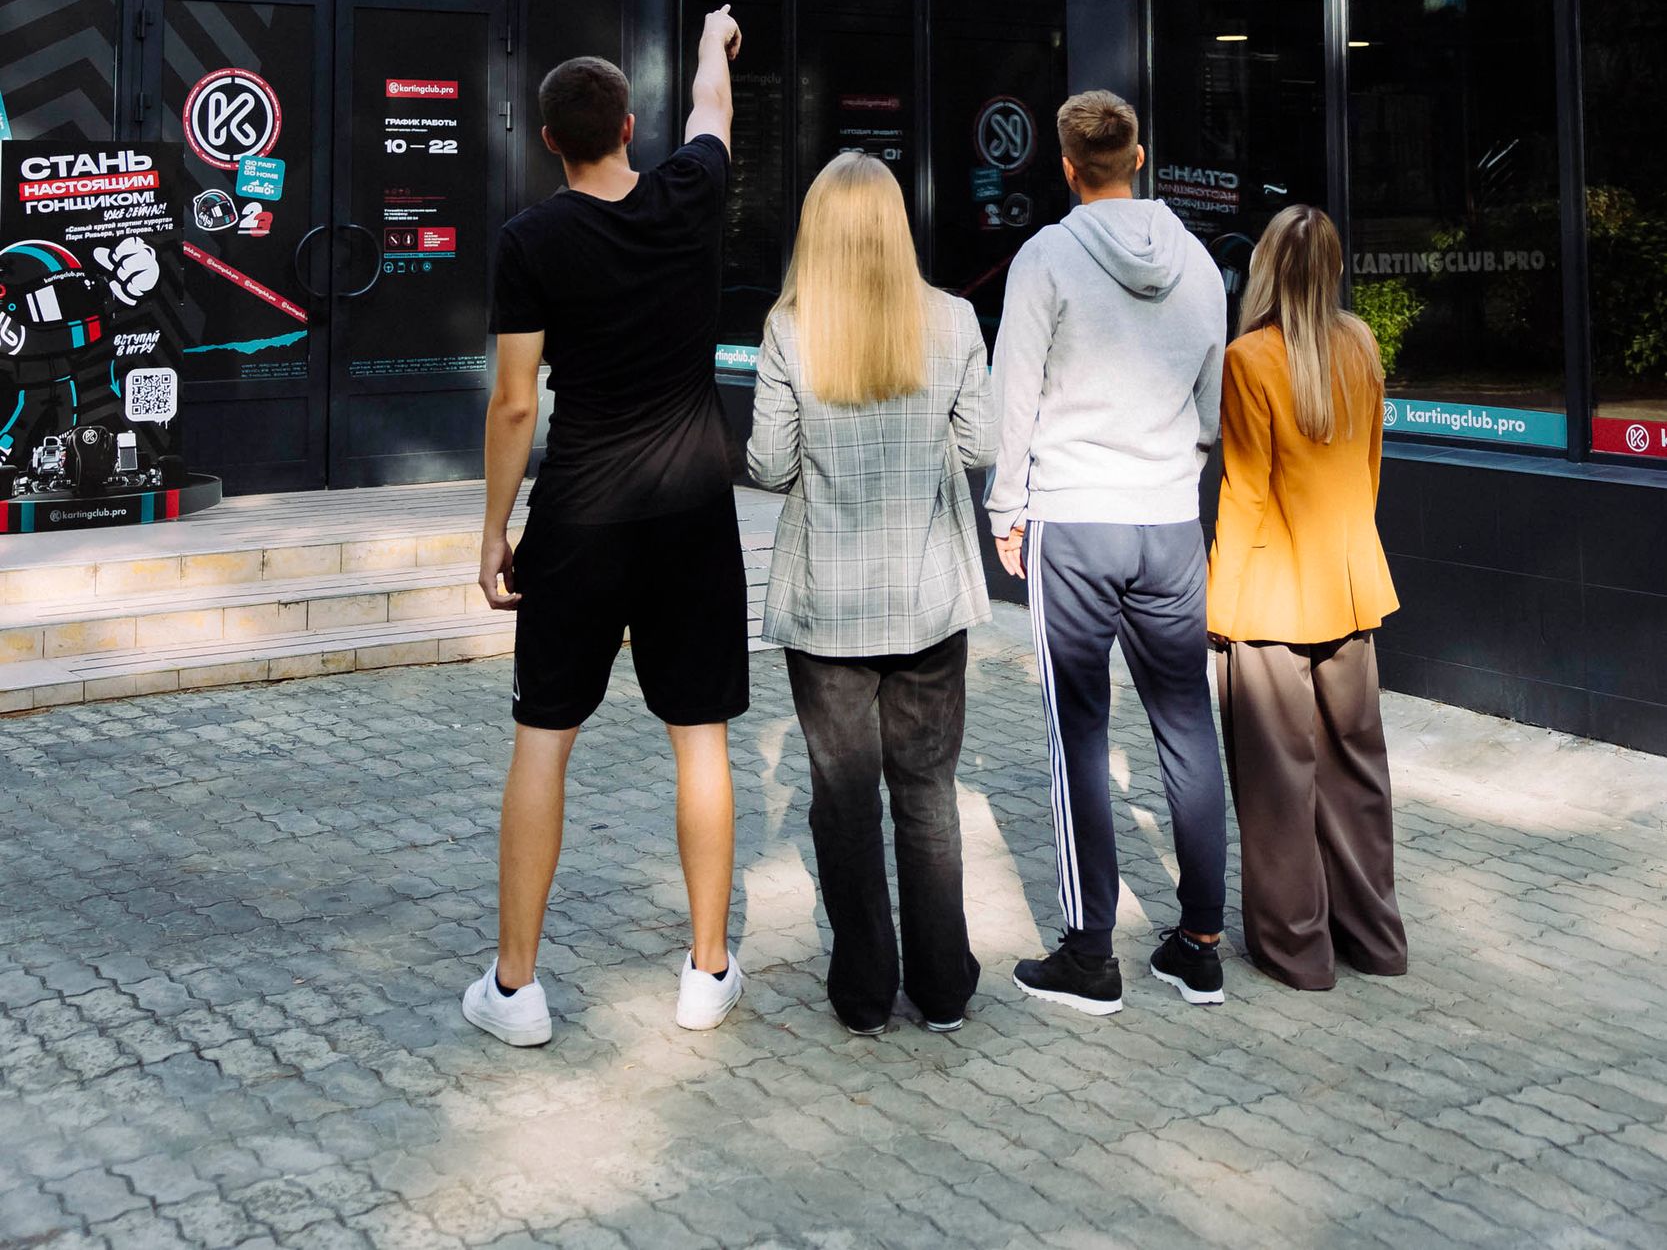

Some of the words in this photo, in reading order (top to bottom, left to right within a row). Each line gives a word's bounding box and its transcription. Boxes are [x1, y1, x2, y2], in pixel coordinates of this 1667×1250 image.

[399, 84, 454, 95] kartingclub.pro
[385, 118, 420, 126] ГРАФИК
[421, 119, 457, 127] РАБОТЫ
[384, 139, 407, 153] 10
[428, 139, 458, 154] 22
[21, 150, 152, 180] СТАНЬ
[258, 161, 277, 169] FAST
[256, 172, 279, 180] HOME
[24, 175, 154, 196] НАСТОЯЩИМ
[26, 191, 155, 214] ГОНЩИКОМ!
[103, 208, 125, 221] УЖЕ
[125, 202, 167, 218] СЕЙЧАС!
[114, 330, 160, 346] ВСТУПАЙ
[116, 345, 125, 356] В
[126, 343, 156, 355] ИГРУ
[1406, 405, 1526, 435] kartingclub.pro
[62, 508, 127, 520] kartingclub.pro
